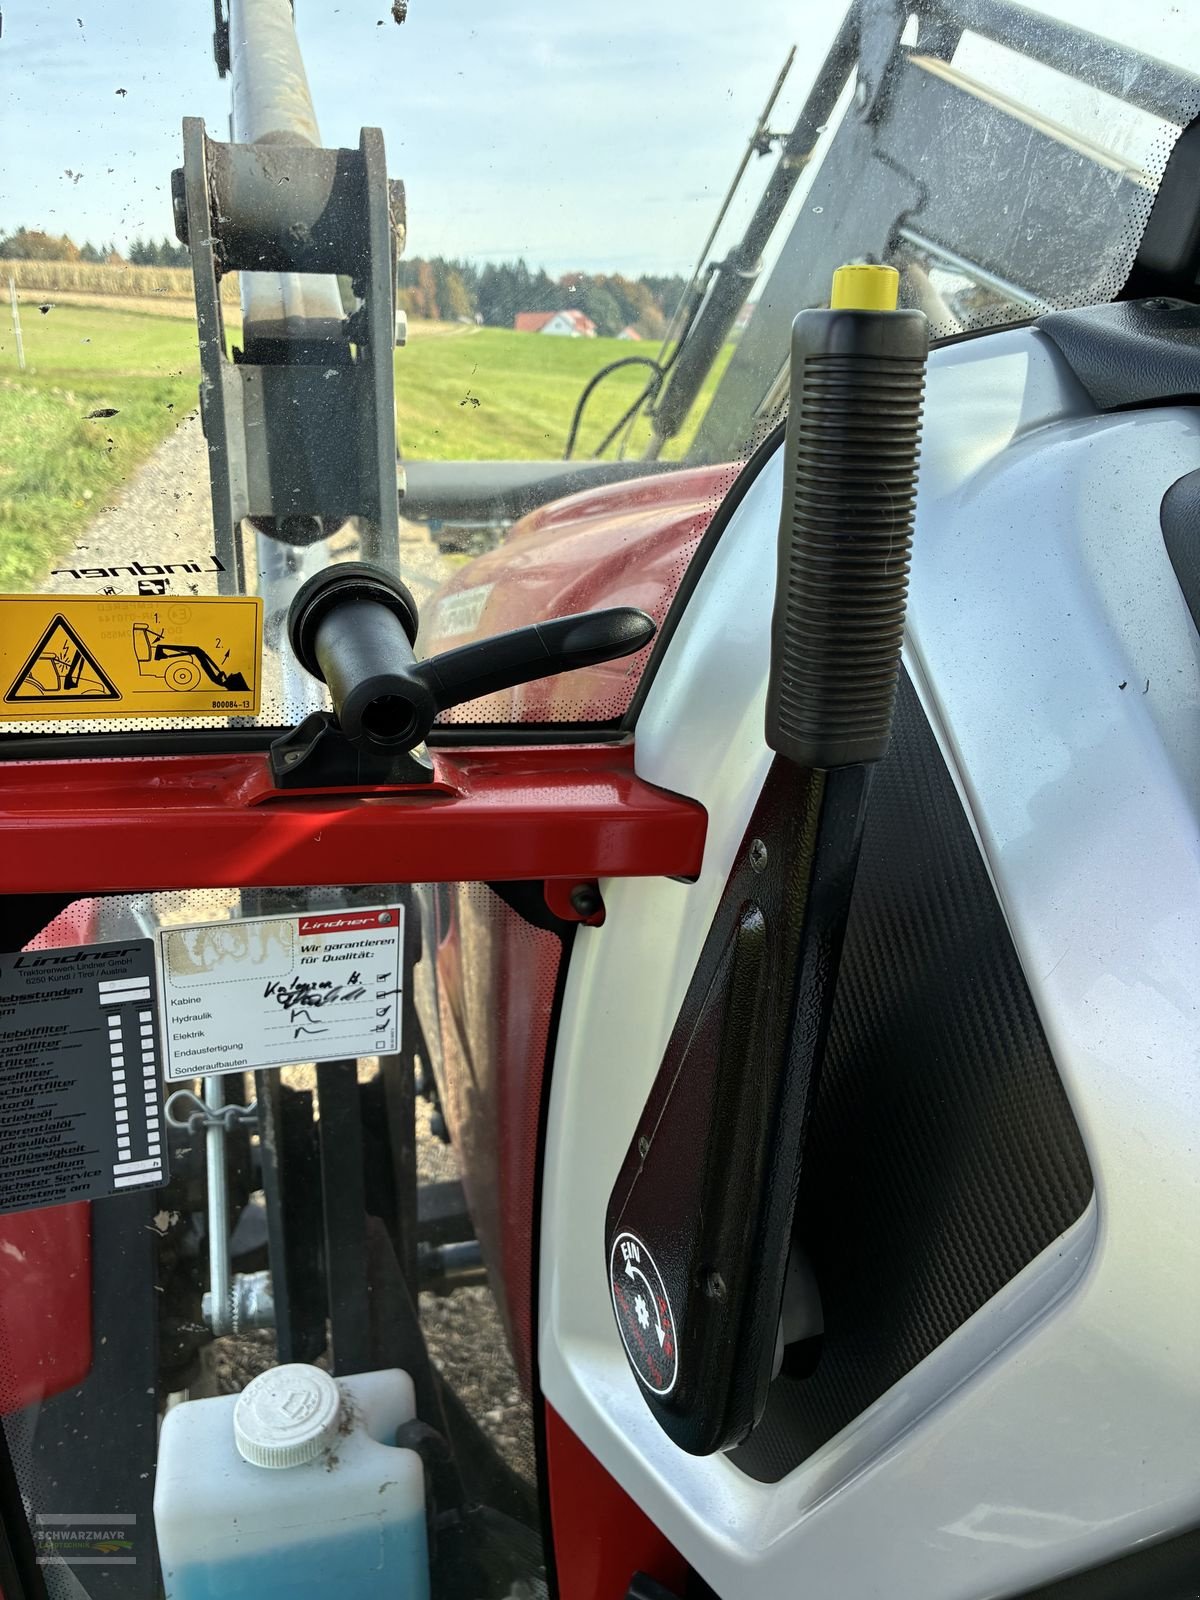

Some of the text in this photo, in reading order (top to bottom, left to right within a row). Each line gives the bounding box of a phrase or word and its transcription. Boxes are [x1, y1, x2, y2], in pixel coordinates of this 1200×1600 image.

[301, 918, 375, 930] Lindner
[301, 938, 395, 953] Wir garantieren
[13, 948, 141, 969] Lindner
[108, 958, 133, 968] GmbH
[300, 951, 374, 965] für Qualität:
[170, 997, 202, 1007] Kabine
[172, 1012, 213, 1024] Hydraulik
[173, 1030, 205, 1041] Elektrik
[174, 1043, 244, 1058] Endausfertigung
[175, 1058, 248, 1075] Sonderaufbauten
[620, 1241, 641, 1264] EIN
